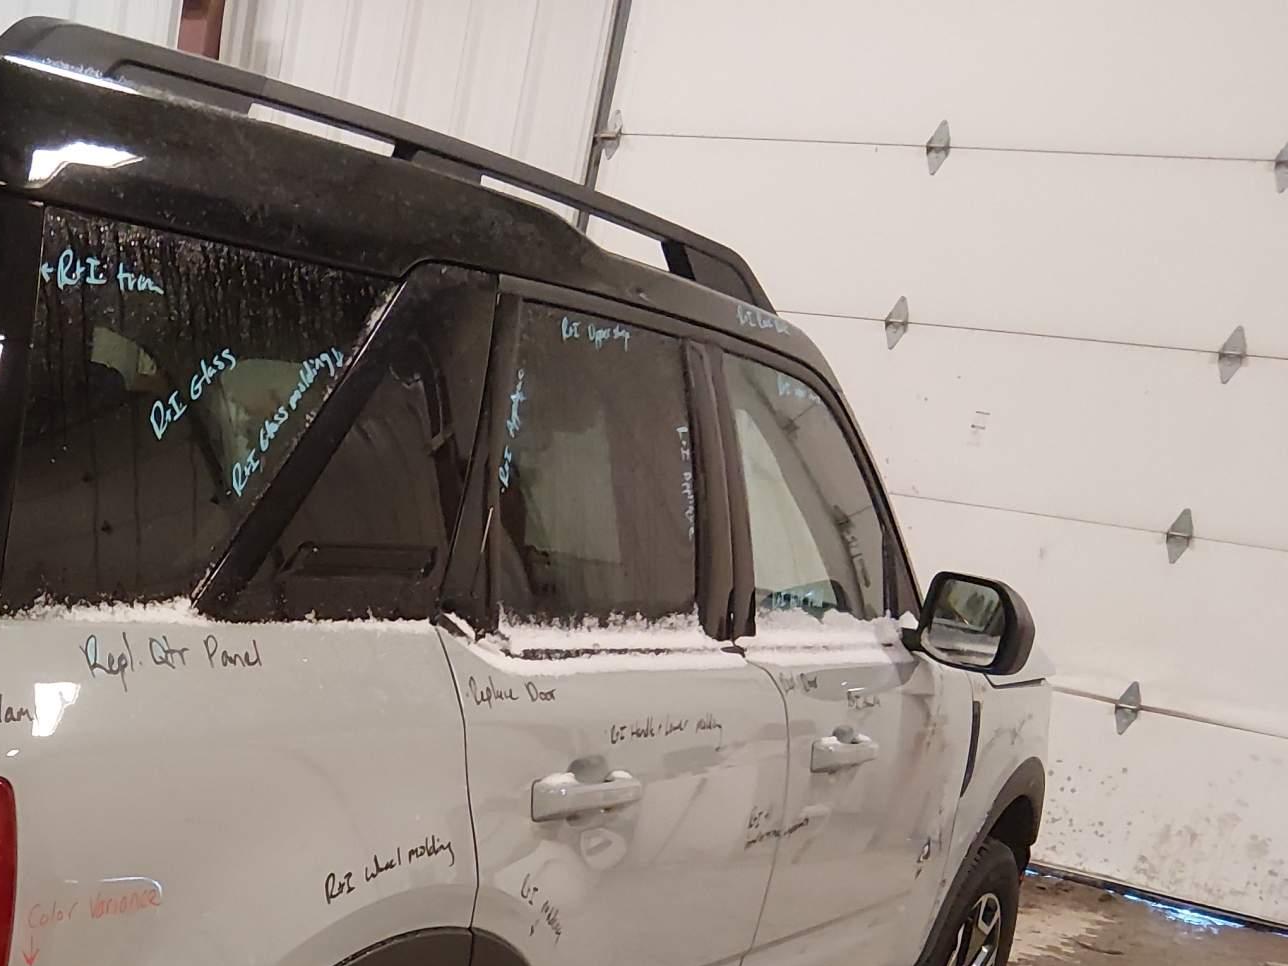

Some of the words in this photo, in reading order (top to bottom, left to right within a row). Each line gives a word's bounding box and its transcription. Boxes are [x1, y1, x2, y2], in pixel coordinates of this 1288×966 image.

[56, 247, 108, 290] R+I
[189, 348, 237, 401] Glass
[148, 634, 191, 669] Qtr
[202, 634, 263, 669] Panel
[469, 675, 520, 708] Replace
[525, 680, 557, 704] Door
[324, 872, 356, 905] R+I
[364, 847, 403, 882] wheel
[27, 900, 79, 929] Color
[88, 888, 162, 919] Variance
